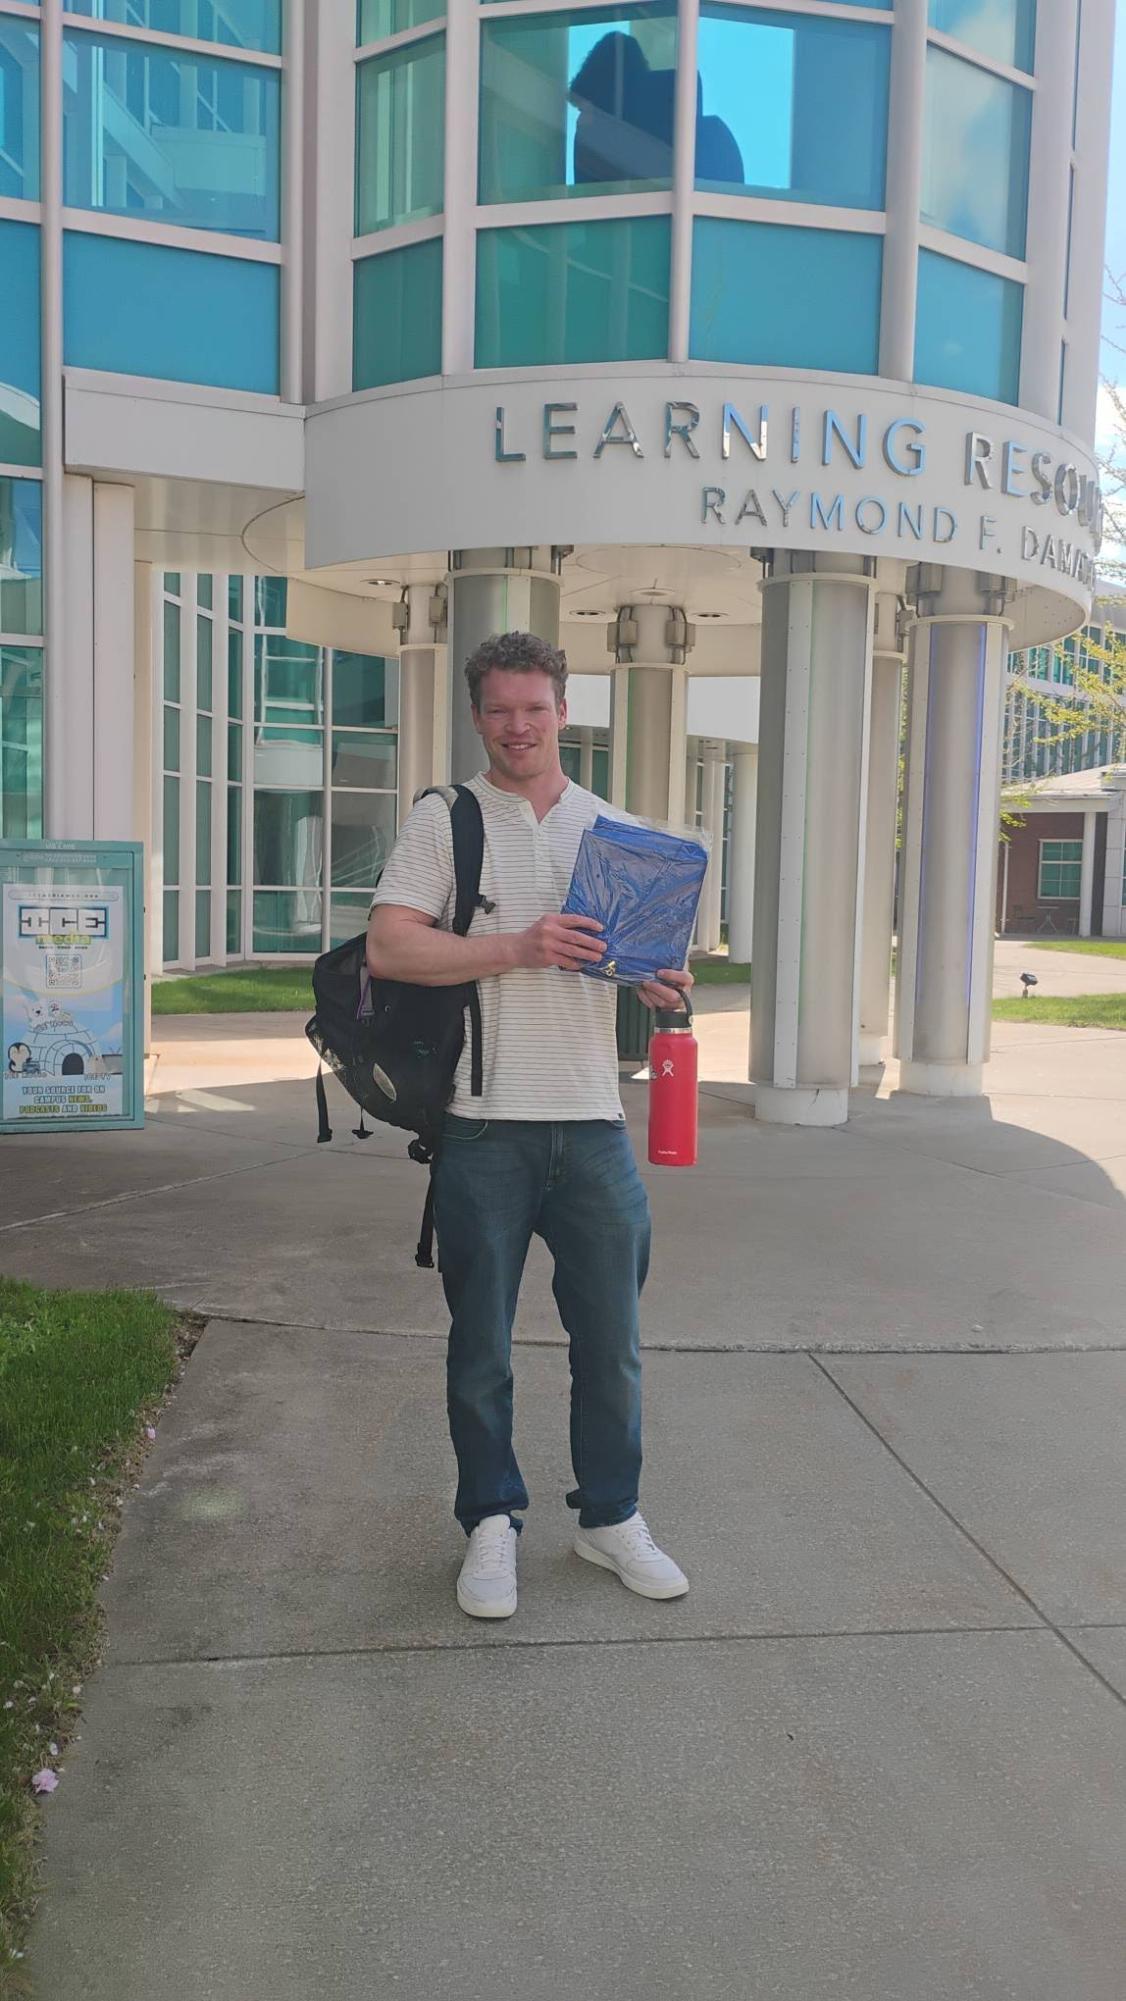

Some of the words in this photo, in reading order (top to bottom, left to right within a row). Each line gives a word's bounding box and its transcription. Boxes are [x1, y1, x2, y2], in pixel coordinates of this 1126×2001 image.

[495, 401, 929, 477] LEARNING
[701, 486, 958, 544] RAYMOND
[979, 516, 1001, 554] F.
[22, 1086, 43, 1095] YOUR
[34, 1096, 67, 1104] CAMPUS
[61, 1105, 78, 1113] AND
